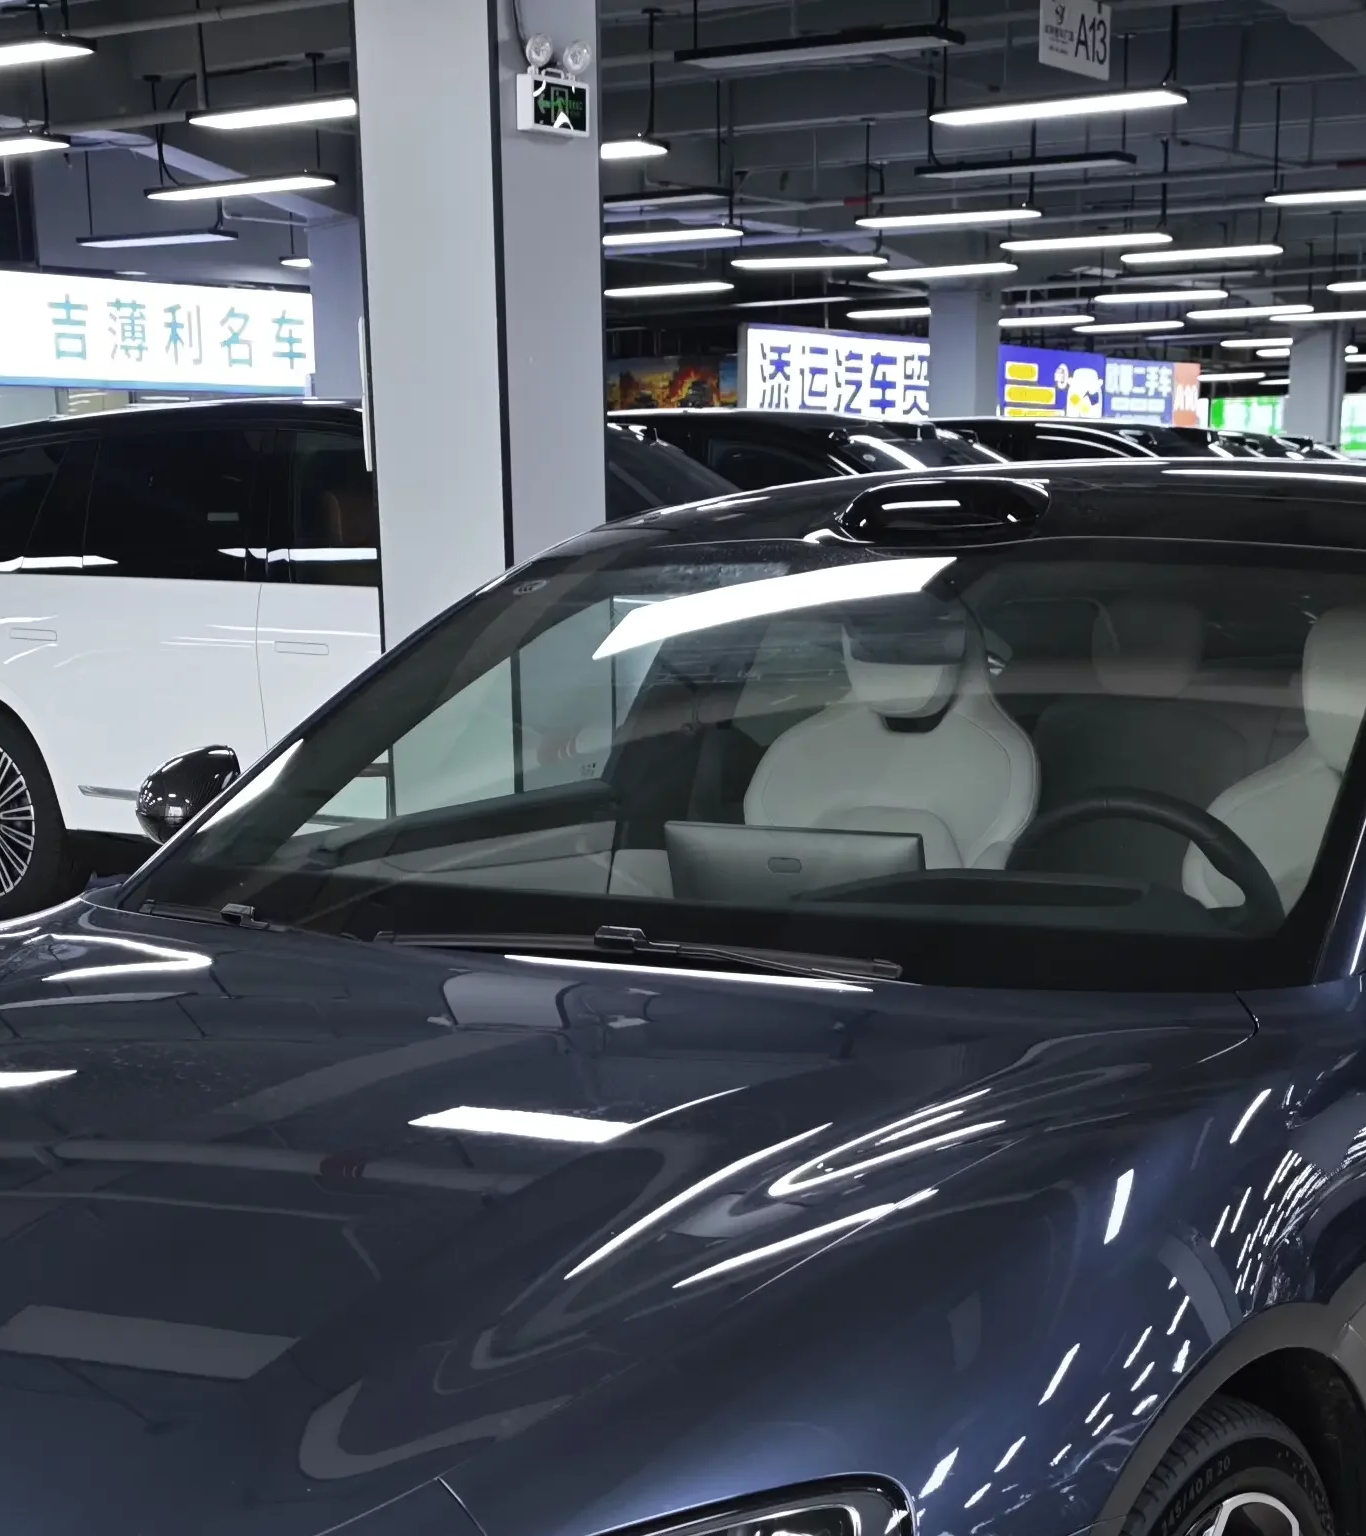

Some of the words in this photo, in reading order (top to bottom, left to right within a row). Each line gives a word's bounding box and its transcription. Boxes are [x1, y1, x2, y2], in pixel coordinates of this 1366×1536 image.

[1075, 13, 1106, 65] A13
[47, 293, 307, 369] 吉薄利名车
